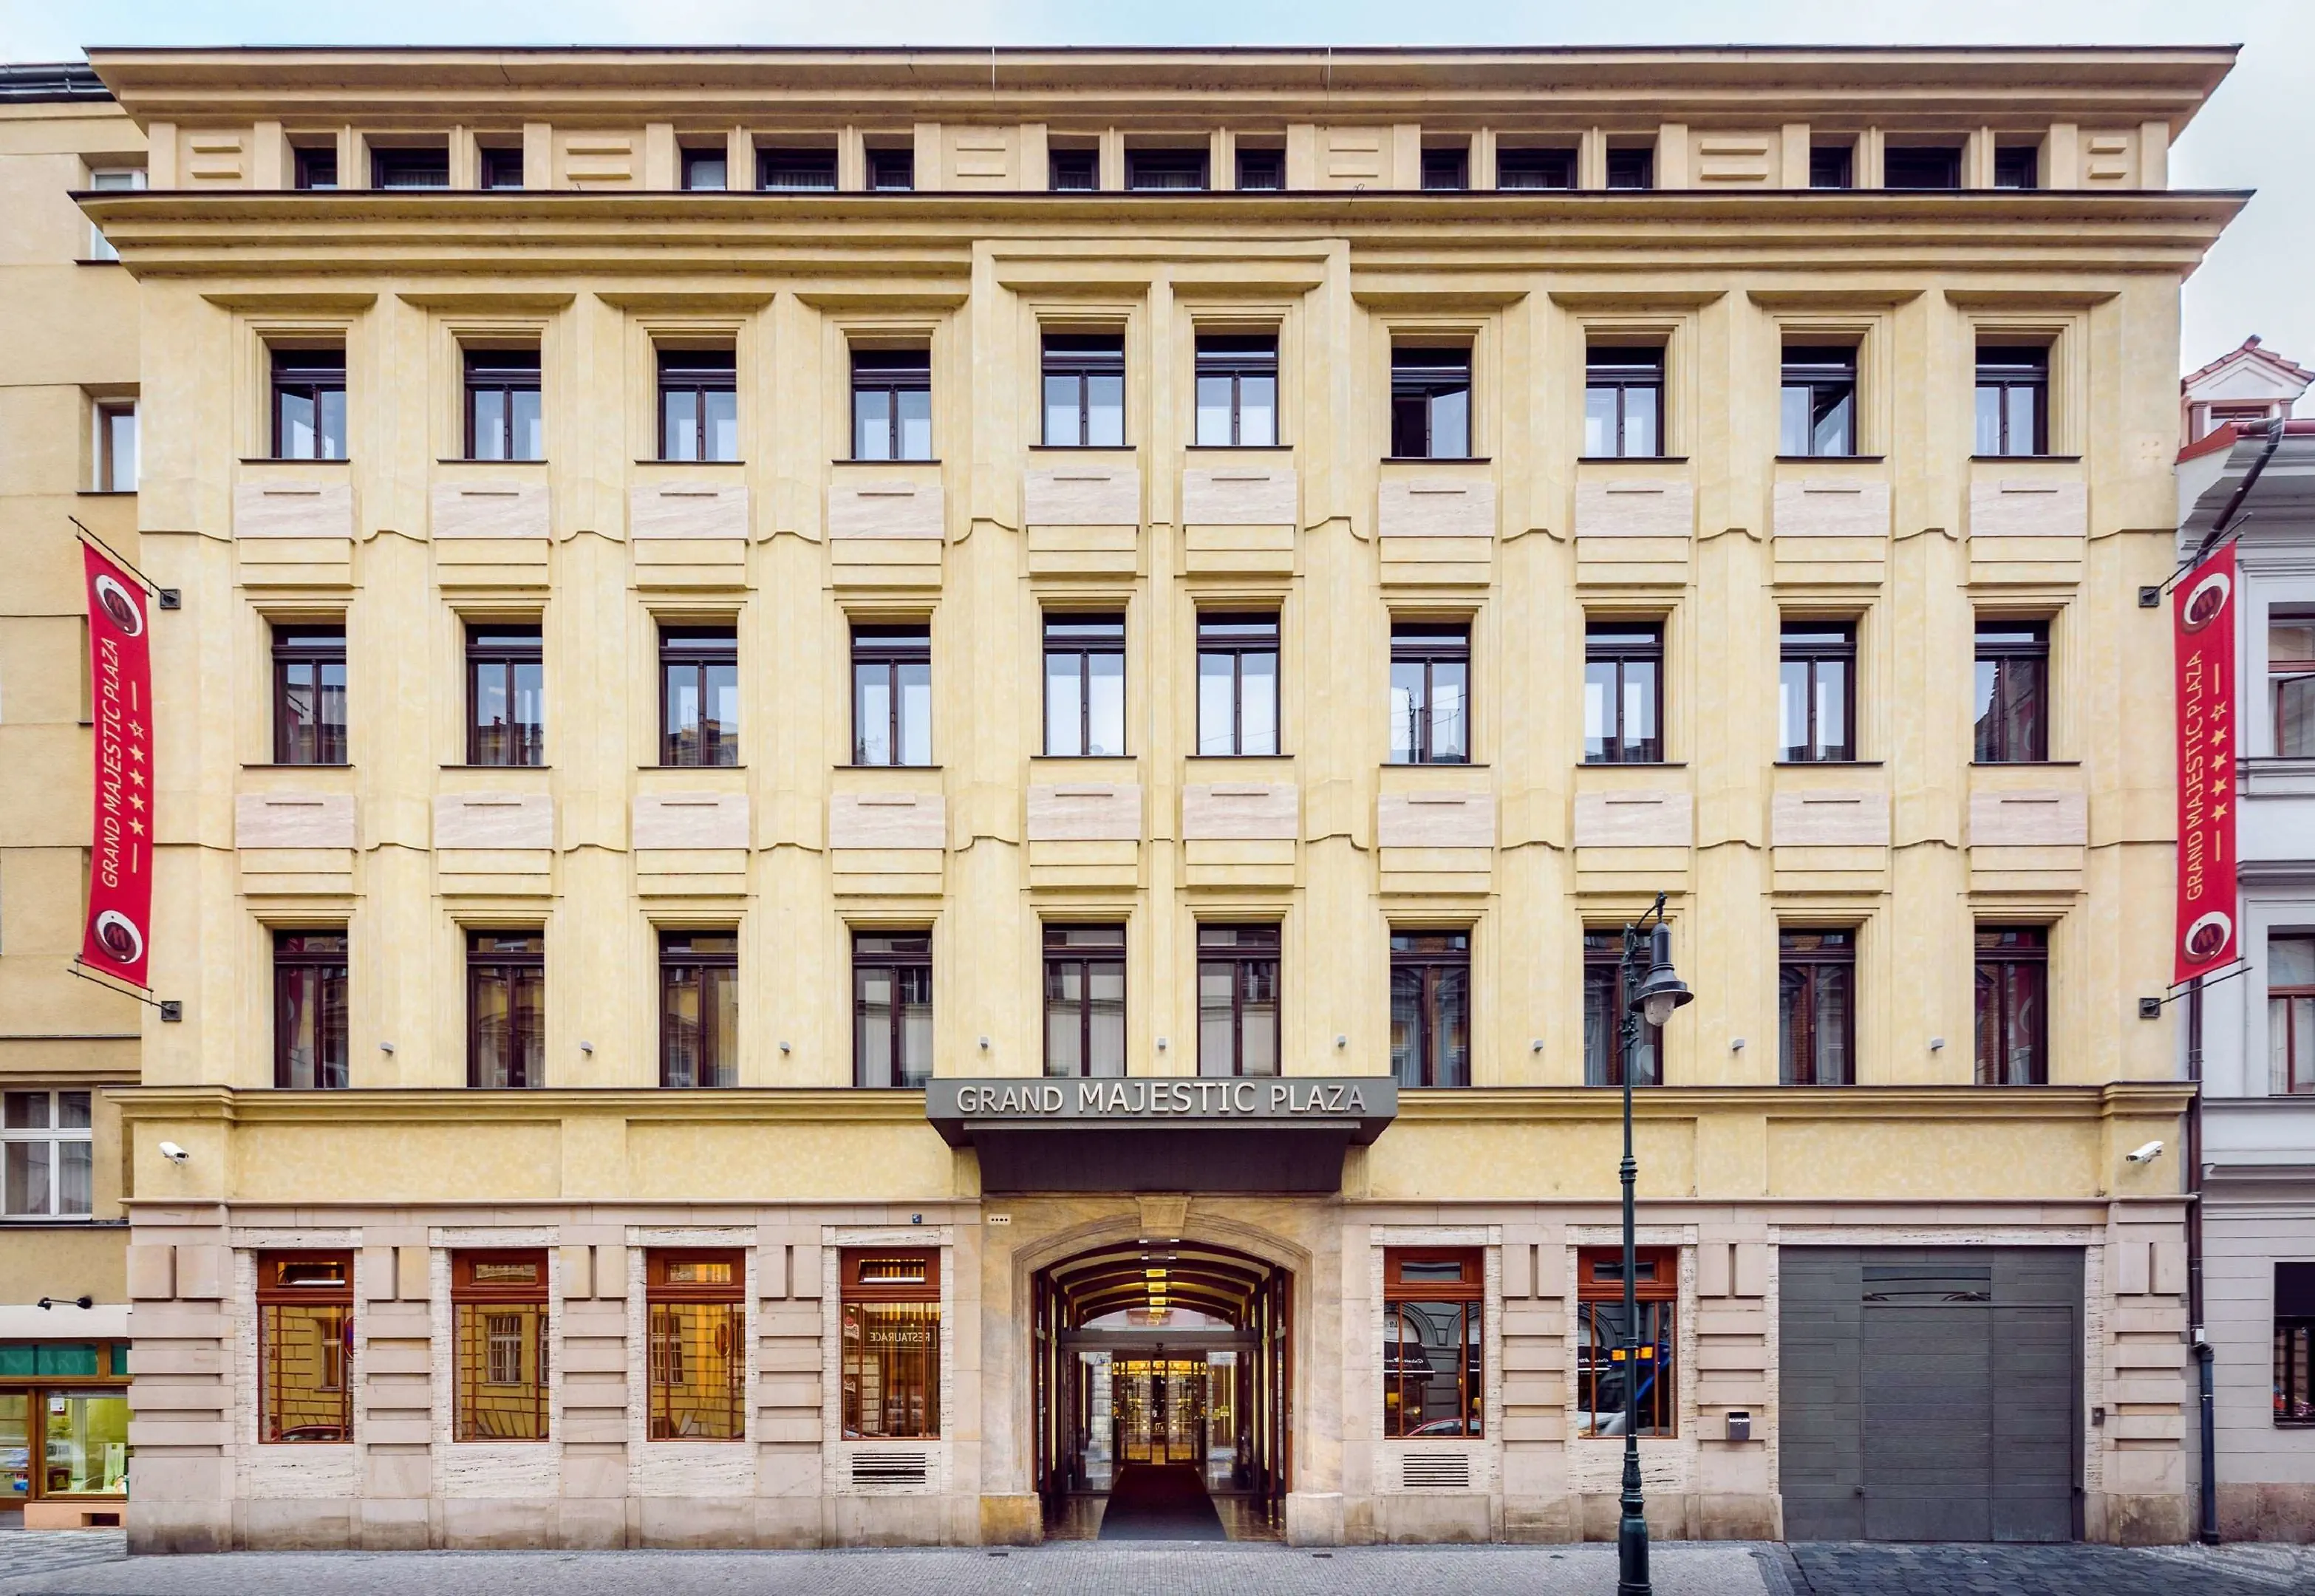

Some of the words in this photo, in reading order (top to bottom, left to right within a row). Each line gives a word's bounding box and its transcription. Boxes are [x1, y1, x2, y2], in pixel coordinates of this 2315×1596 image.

[101, 638, 120, 703] PLAZA
[2186, 650, 2203, 718] PLAZA
[102, 699, 121, 816] MAJESTIC
[2186, 716, 2203, 831] MAJESTIC
[102, 816, 120, 887] GRAND
[2186, 831, 2203, 901] GRAND
[957, 1086, 1064, 1112] GRAND
[1078, 1082, 1256, 1112] MAJESTIC
[1270, 1085, 1366, 1111] PLAZA
